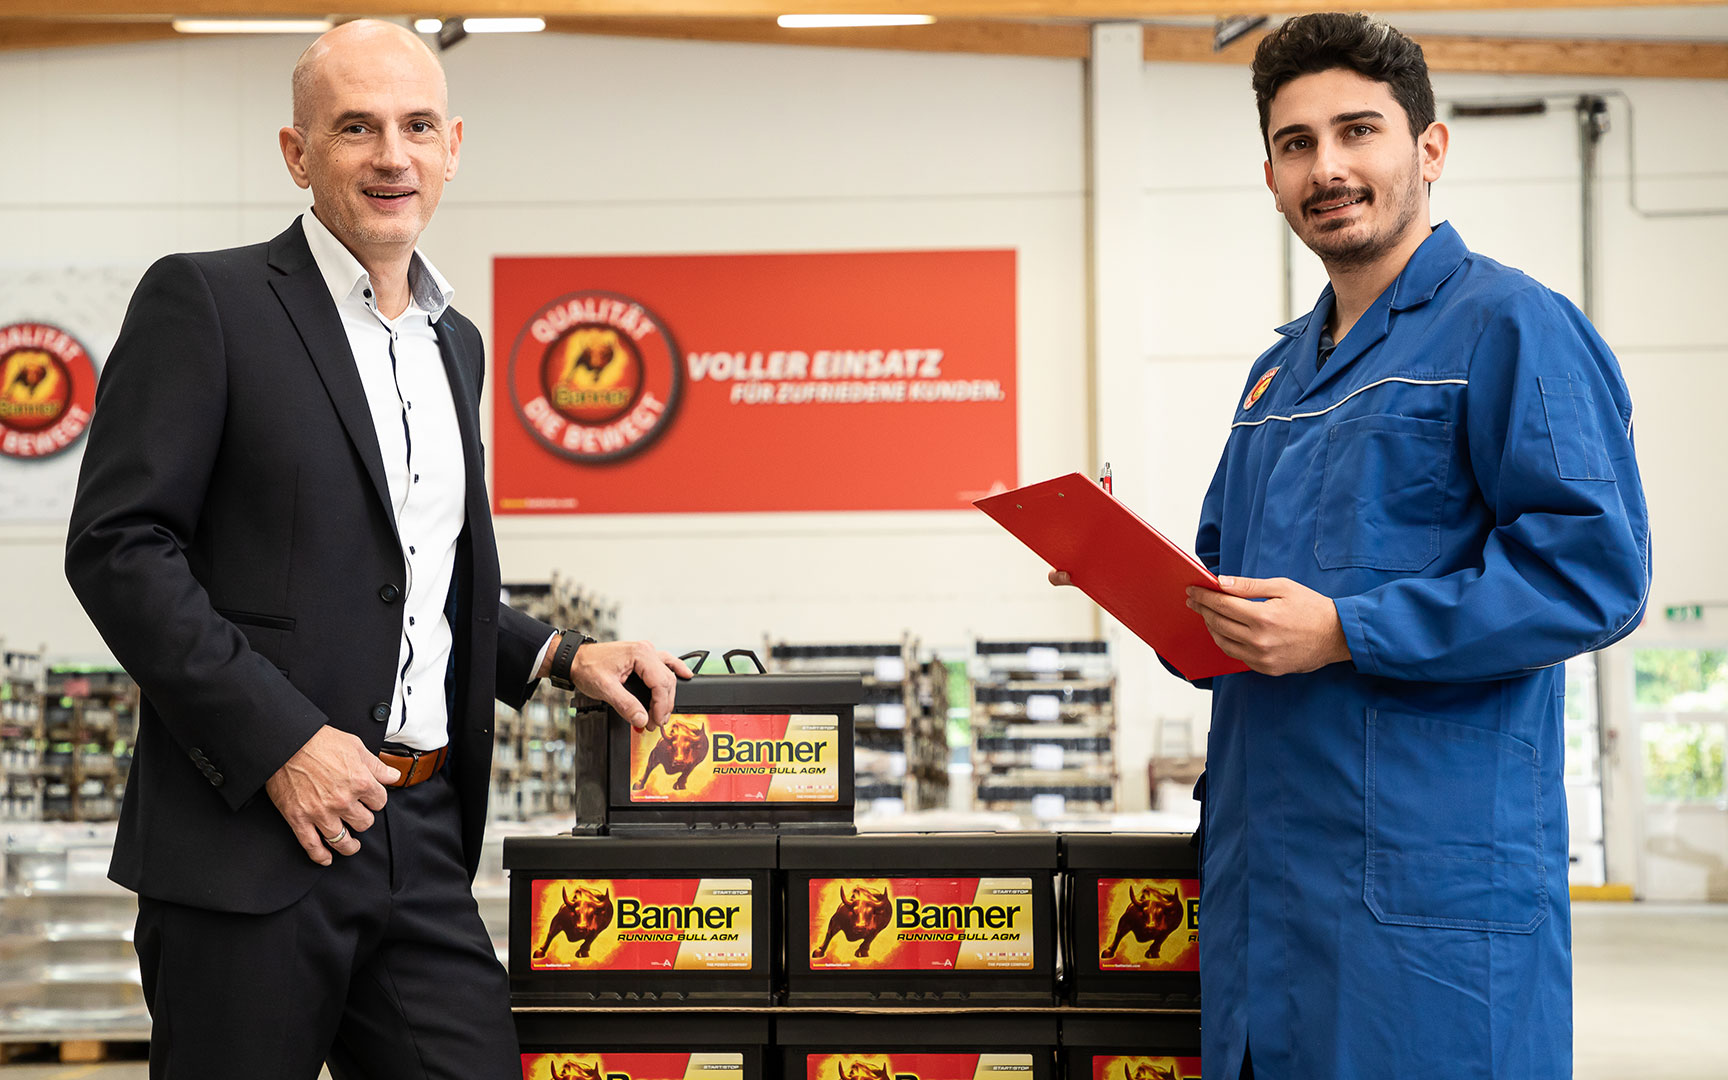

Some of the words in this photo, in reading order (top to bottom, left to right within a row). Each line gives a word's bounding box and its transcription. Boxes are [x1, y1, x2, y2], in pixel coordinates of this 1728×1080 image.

[531, 298, 656, 343] QUALITÄT
[0, 326, 83, 362] ALITÄT
[687, 351, 808, 381] VOLLER
[811, 349, 943, 379] EINSATZ
[730, 381, 775, 404] FÜR
[777, 381, 906, 404] ZUFRIEDENE
[524, 396, 566, 440] DIE
[562, 392, 665, 452] BEWEGT
[712, 734, 827, 763] Banner
[616, 899, 740, 929] Banner
[896, 898, 1021, 929] Banner
[897, 933, 954, 941] RUNNING
[957, 933, 988, 941] BULL
[991, 933, 1020, 941] AGM
